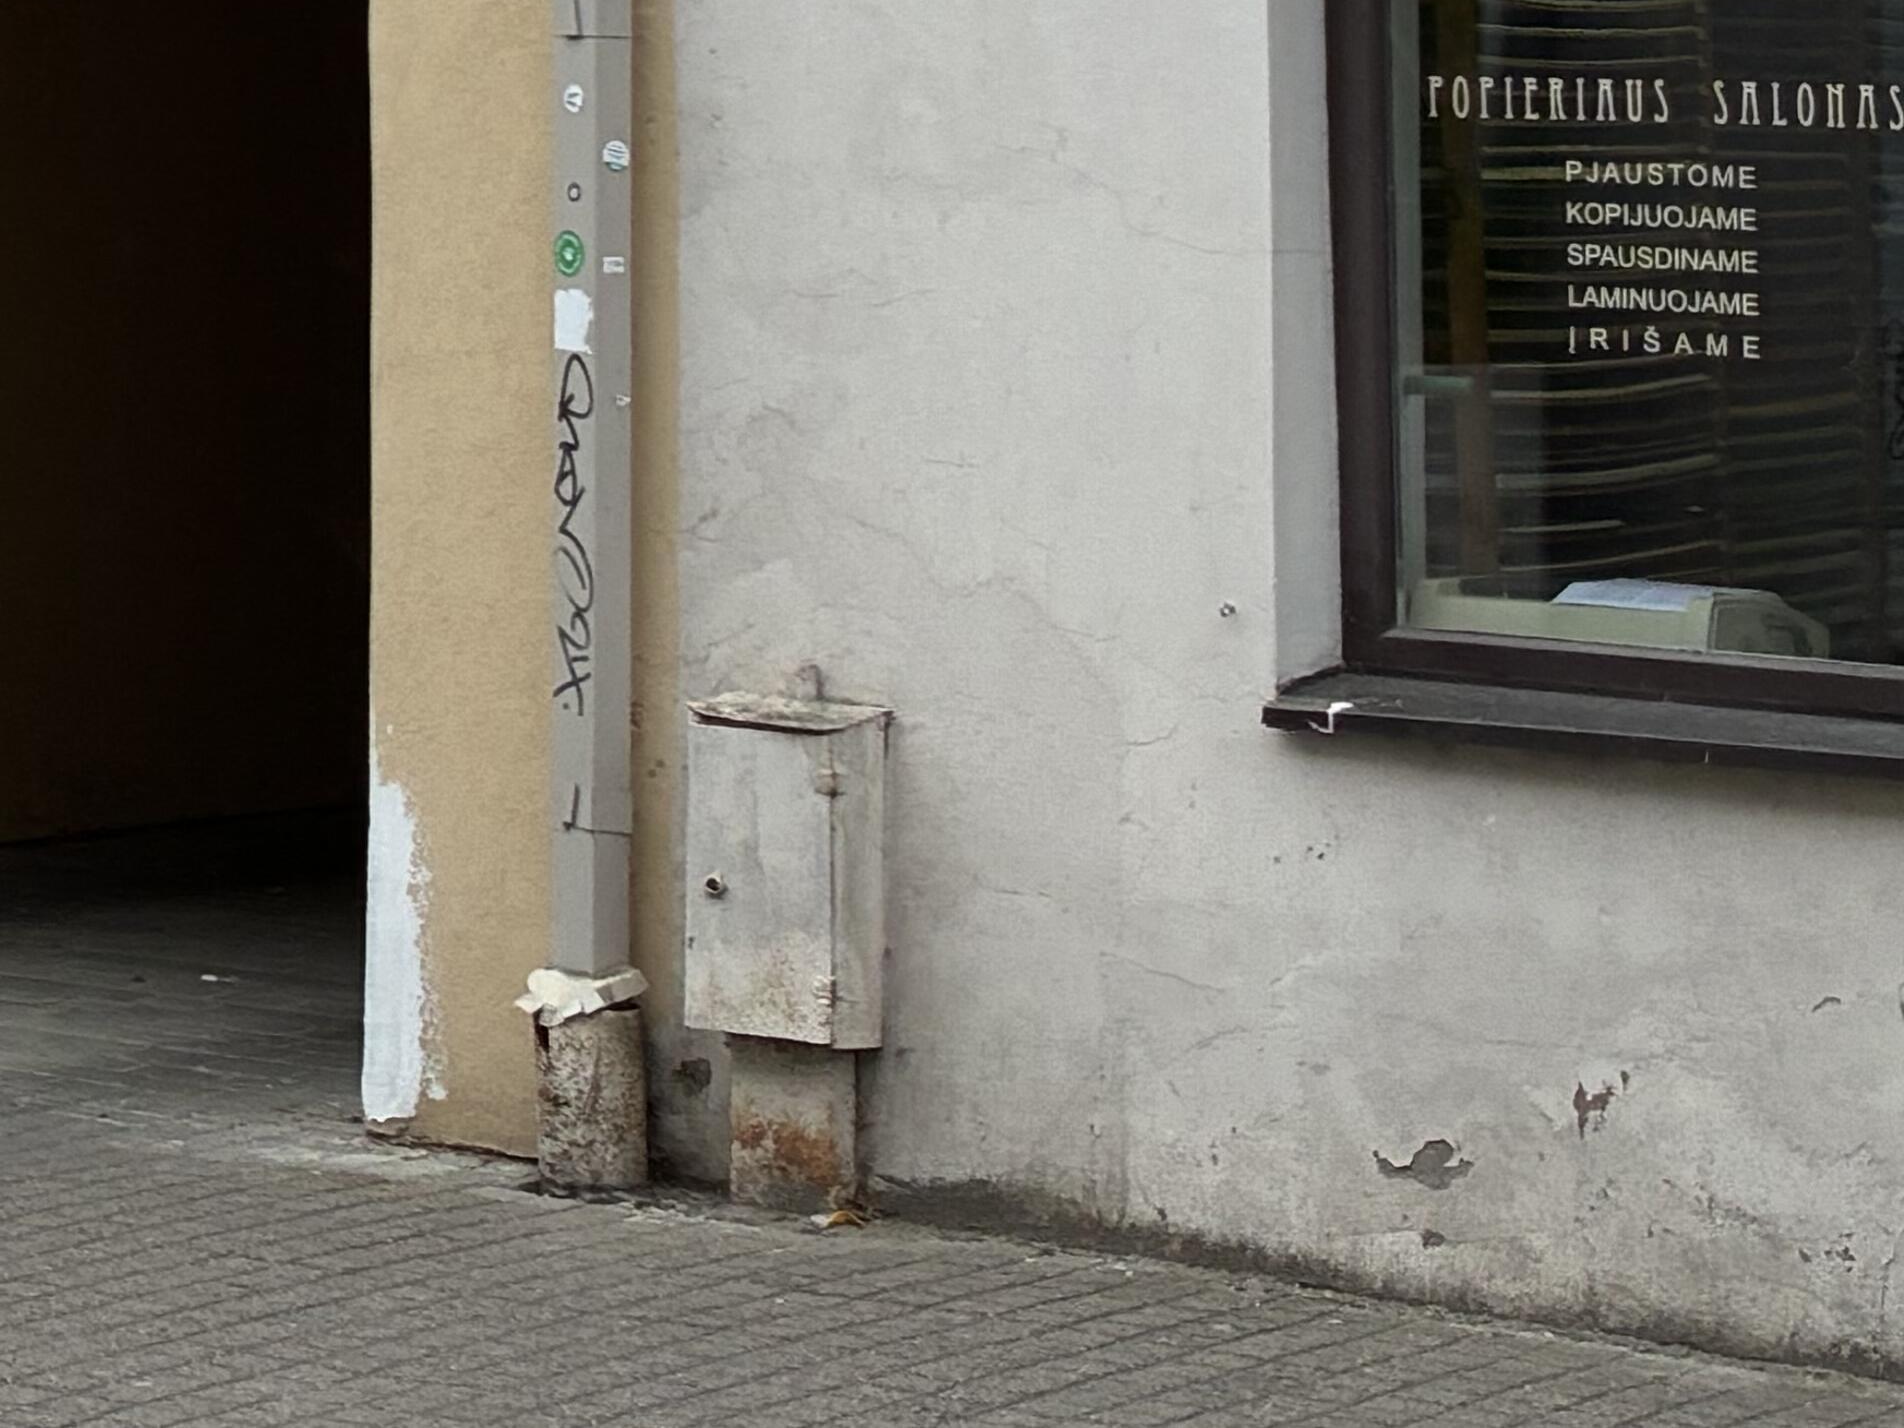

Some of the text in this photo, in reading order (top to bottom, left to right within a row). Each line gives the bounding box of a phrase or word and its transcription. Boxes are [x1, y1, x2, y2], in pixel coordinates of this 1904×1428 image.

[1426, 75, 1904, 132] POPIERIAUS SALONAS
[1564, 159, 1759, 189] PJAUSTOME
[1565, 200, 1759, 232] KOPIJUOJAME
[1566, 242, 1760, 275] SPAUSDINAME
[1566, 283, 1761, 316] LAMINUOJAME
[1567, 325, 1762, 360] ĮRIŠAME
